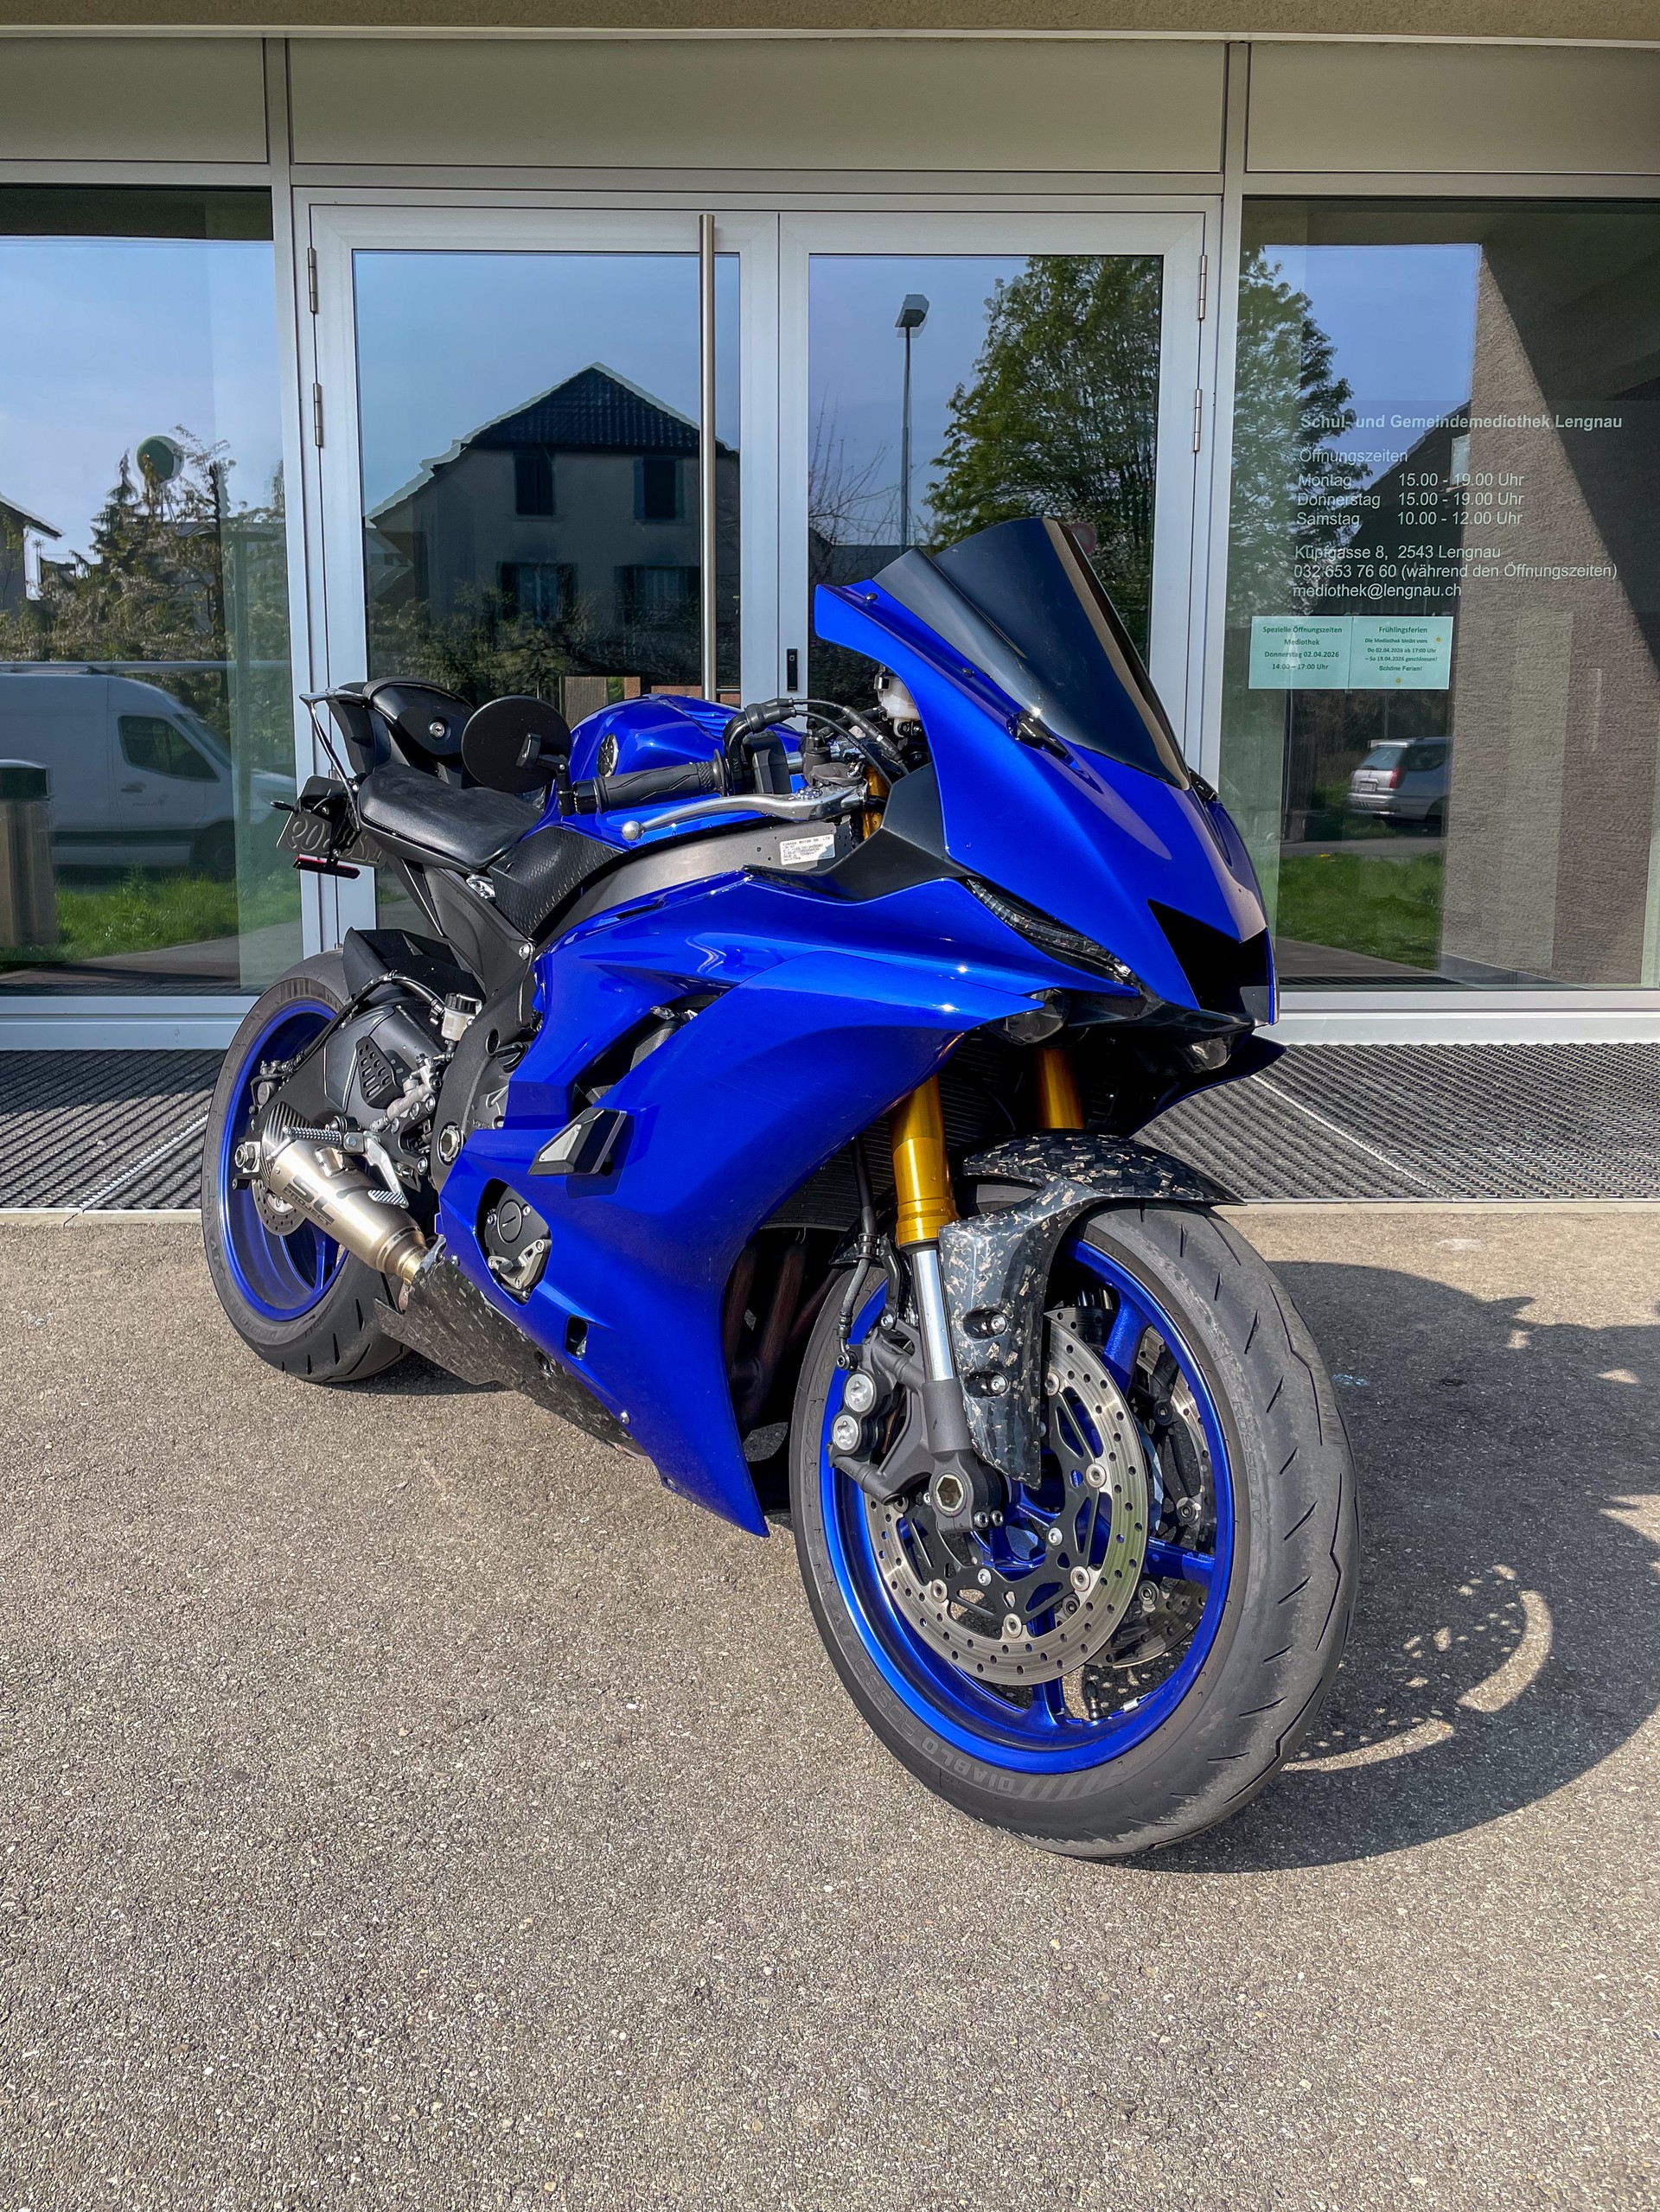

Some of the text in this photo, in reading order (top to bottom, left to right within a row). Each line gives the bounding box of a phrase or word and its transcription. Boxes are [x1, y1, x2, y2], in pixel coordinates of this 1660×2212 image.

[1300, 415, 1623, 431] Schul- und Gemeindemediothek Lengnau
[1299, 446, 1408, 465] Öffnungszeiten
[1299, 473, 1352, 489] Montag
[1399, 474, 1438, 487] 15.00
[1453, 474, 1493, 487] 19.00
[1498, 474, 1524, 487] Uhr
[1297, 492, 1381, 509] Donnerstag
[1399, 493, 1438, 506] 15.00
[1453, 493, 1493, 506] 19.00
[1498, 493, 1524, 506] Uhr
[1297, 512, 1361, 527] Samstag
[1397, 512, 1436, 525] 10.00
[1451, 512, 1491, 525] 12.00
[1497, 512, 1523, 525] Uhr
[1295, 545, 1501, 563] Küpfgasse 8, 2543 Lengnau
[1293, 564, 1618, 581] 032 653 76 60 (während den Öffnungszeiten)
[1293, 583, 1461, 600] mediothek@lengnau.ch
[1378, 626, 1427, 634] Frühlingsferien
[854, 1658, 917, 1737] ROSSO
[921, 1737, 1016, 1794] DIABLO
